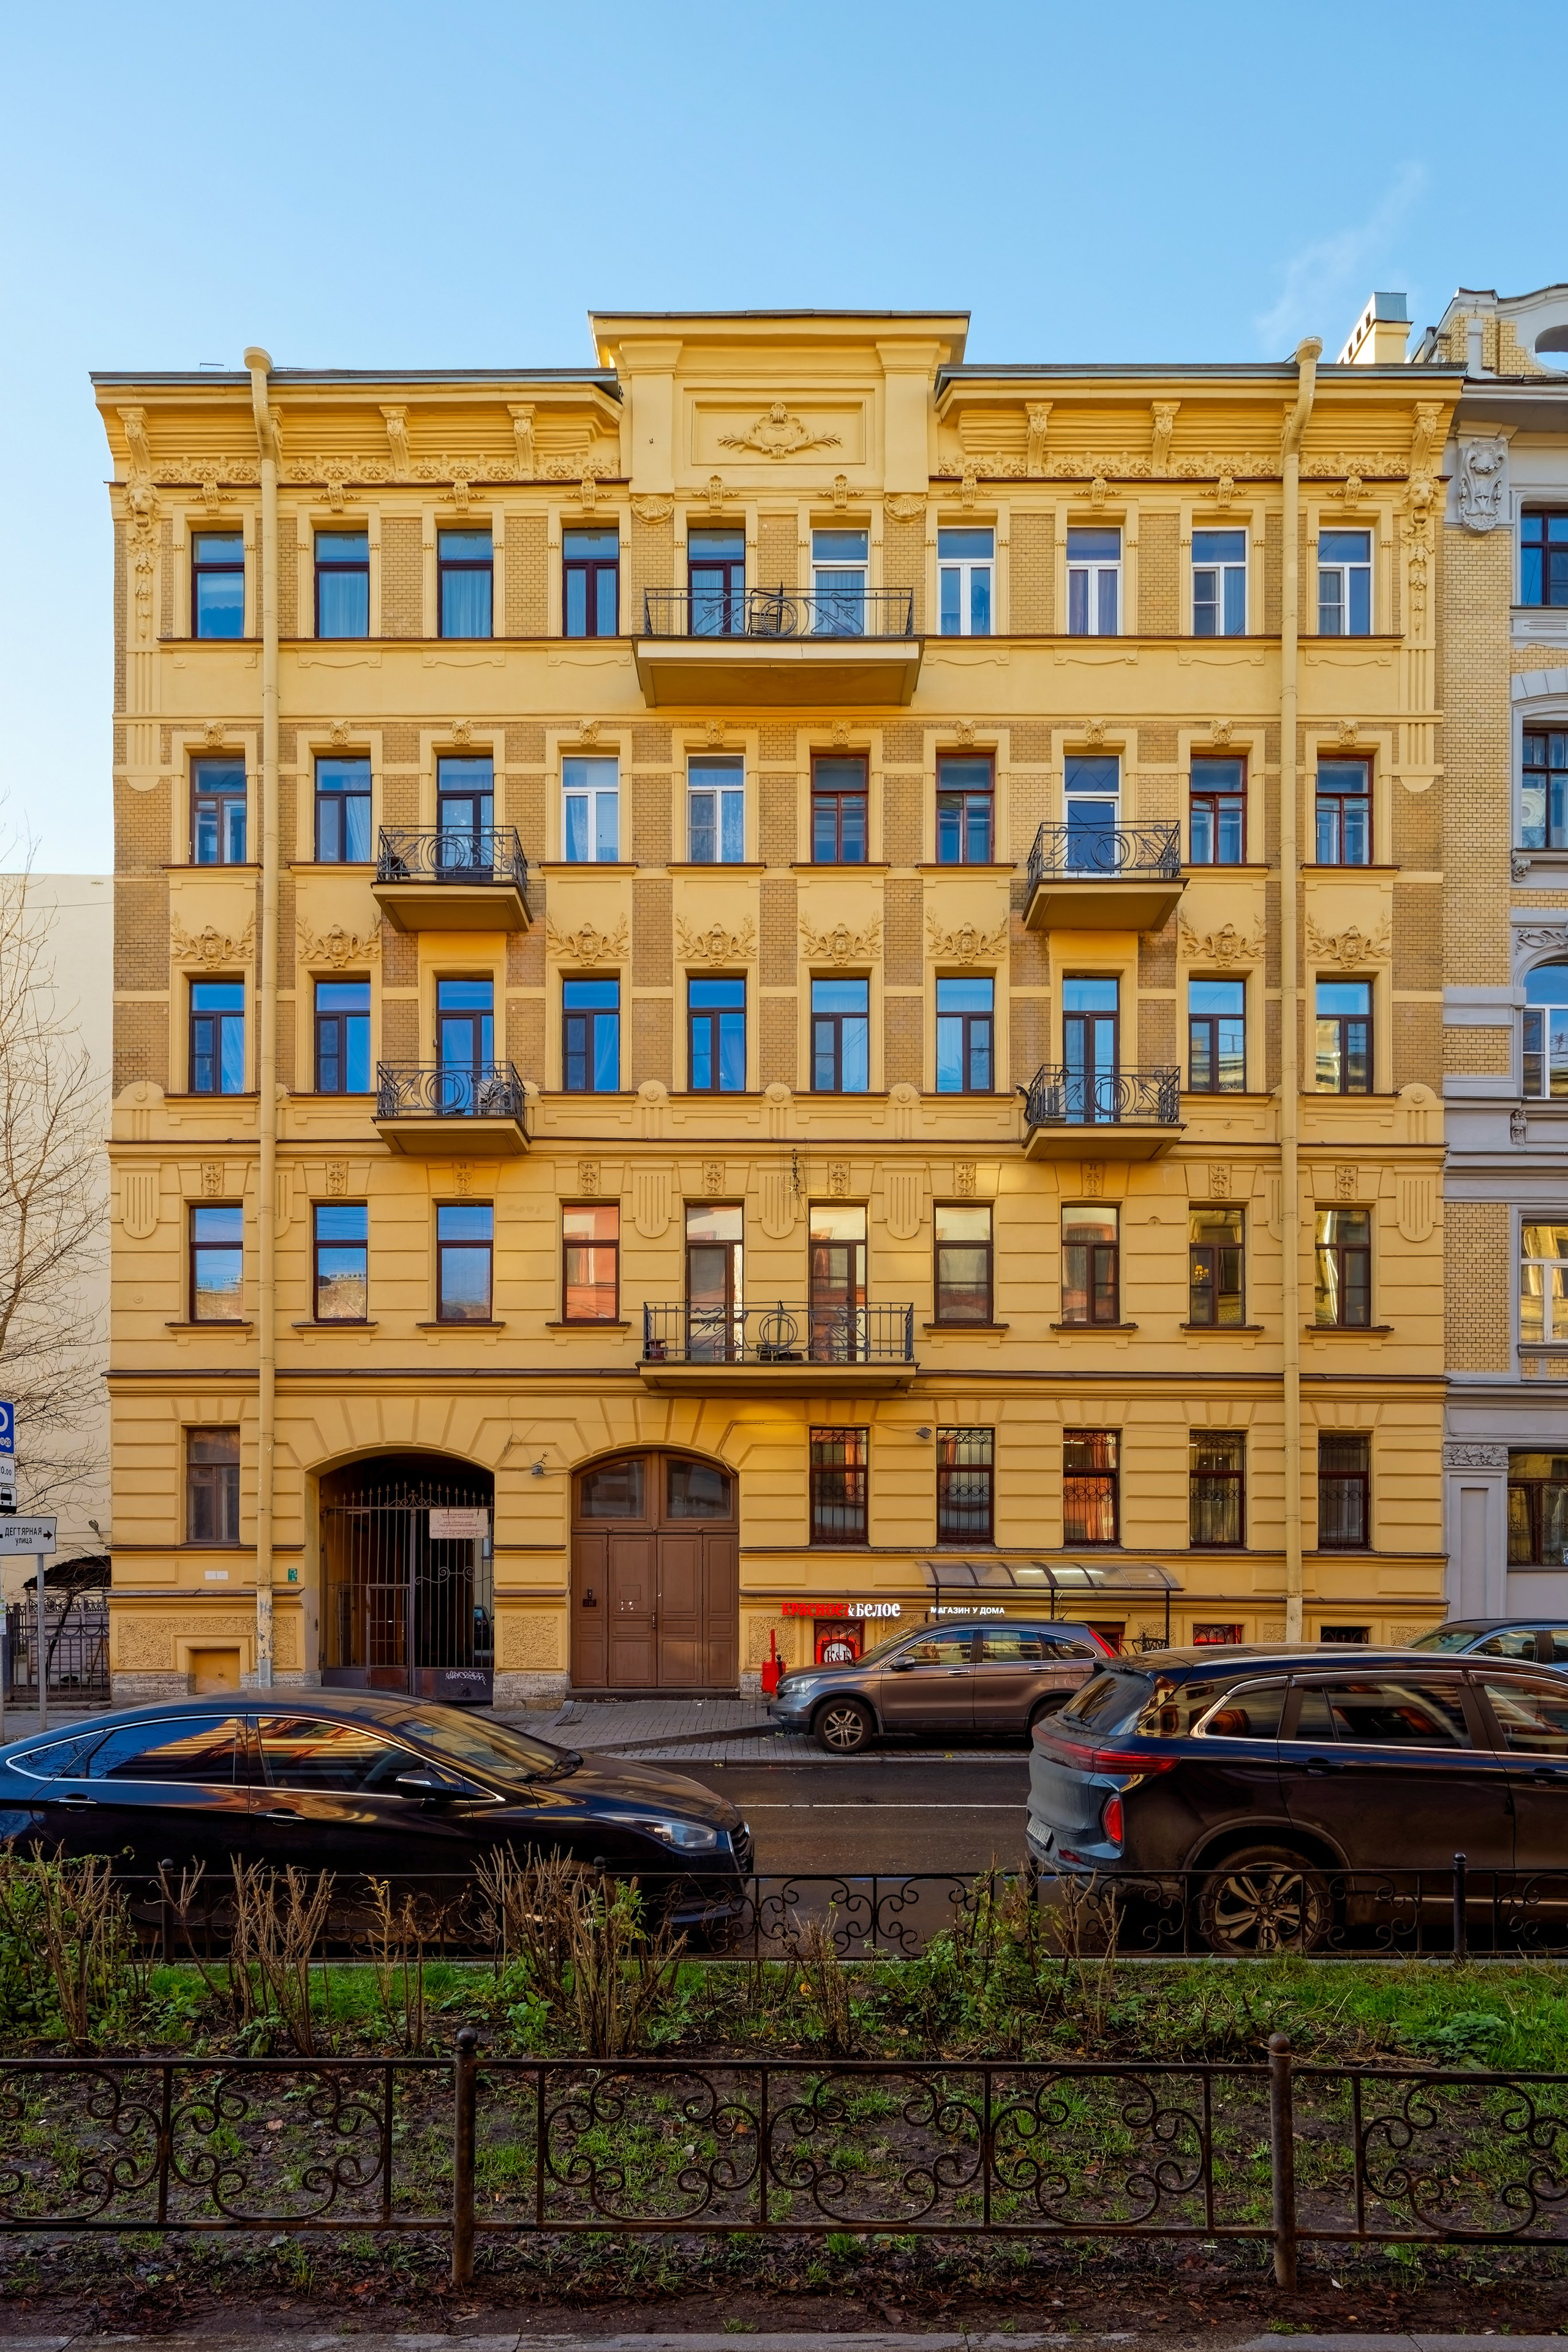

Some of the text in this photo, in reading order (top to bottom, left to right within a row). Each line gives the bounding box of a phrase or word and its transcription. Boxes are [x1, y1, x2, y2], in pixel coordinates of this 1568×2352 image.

[0, 1466, 12, 1476] 0.00
[5, 1527, 42, 1537] ДЕГТЯРНАЯ
[15, 1537, 32, 1546] улица
